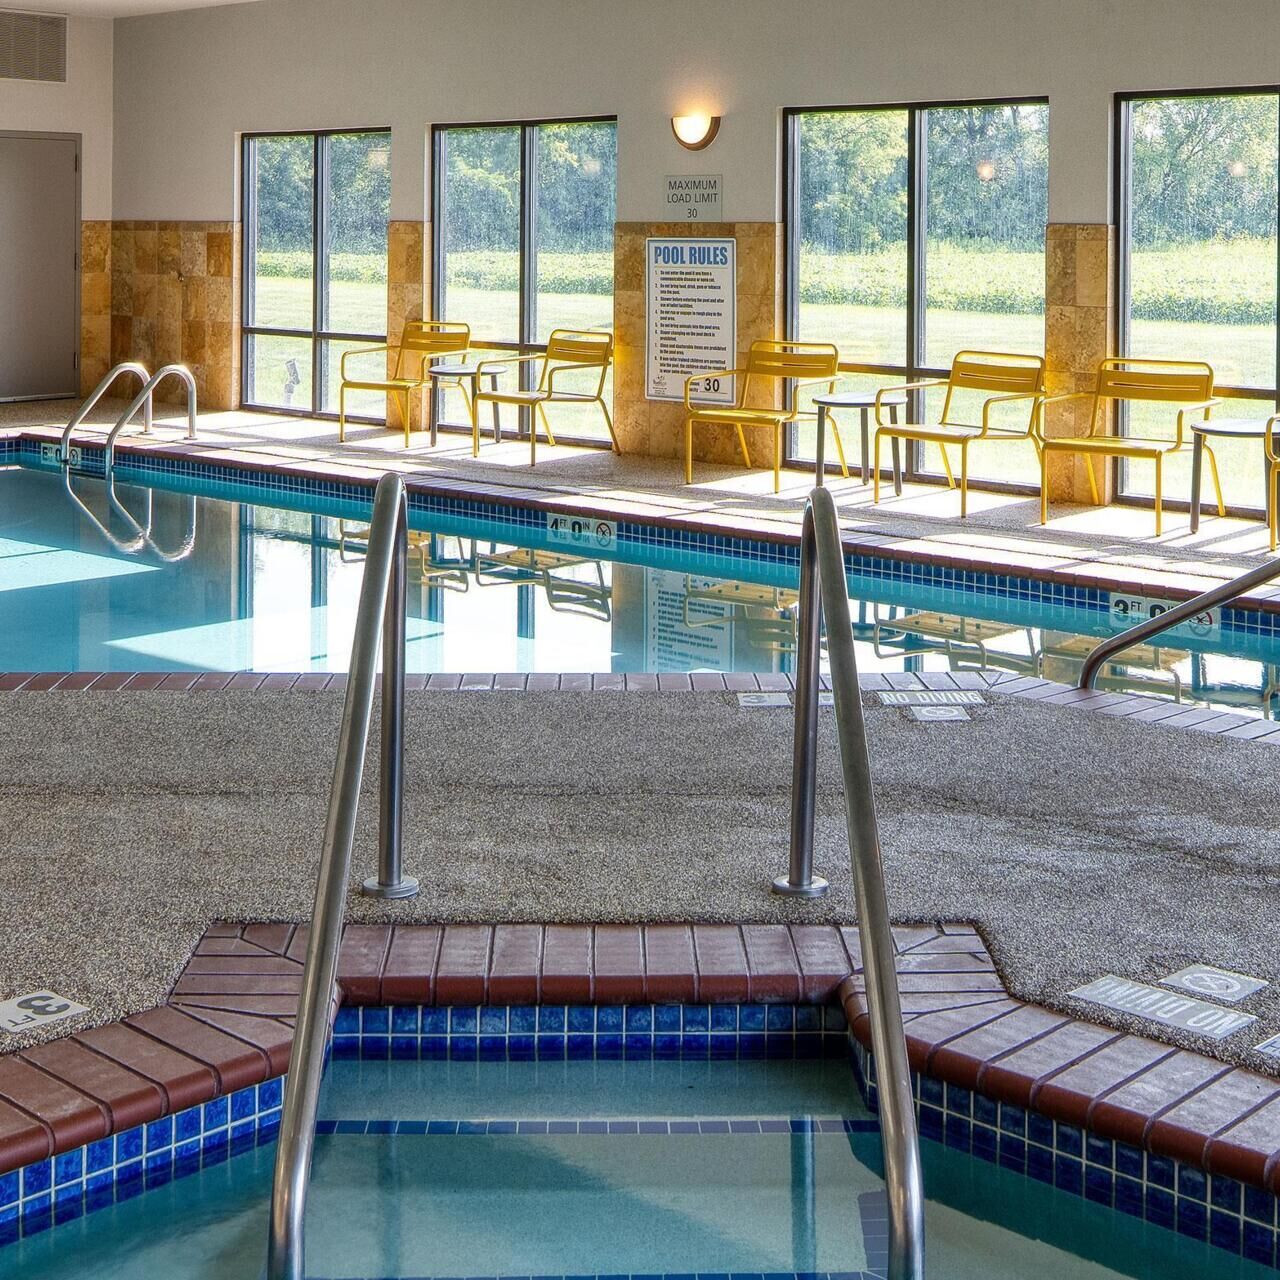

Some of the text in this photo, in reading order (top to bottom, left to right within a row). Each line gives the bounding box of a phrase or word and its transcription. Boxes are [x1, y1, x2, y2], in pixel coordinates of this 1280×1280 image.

[668, 180, 717, 191] MAXIMUM
[666, 193, 718, 204] LOAD LIMIT
[686, 208, 698, 218] 30
[654, 245, 728, 266] POOL RULES
[704, 378, 720, 392] 30
[560, 518, 567, 527] FT
[582, 522, 590, 530] IN
[1130, 601, 1142, 612] FT
[880, 692, 984, 704] NO DIVING
[7, 995, 71, 1028] 3 FT
[1187, 1009, 1249, 1034] NO
